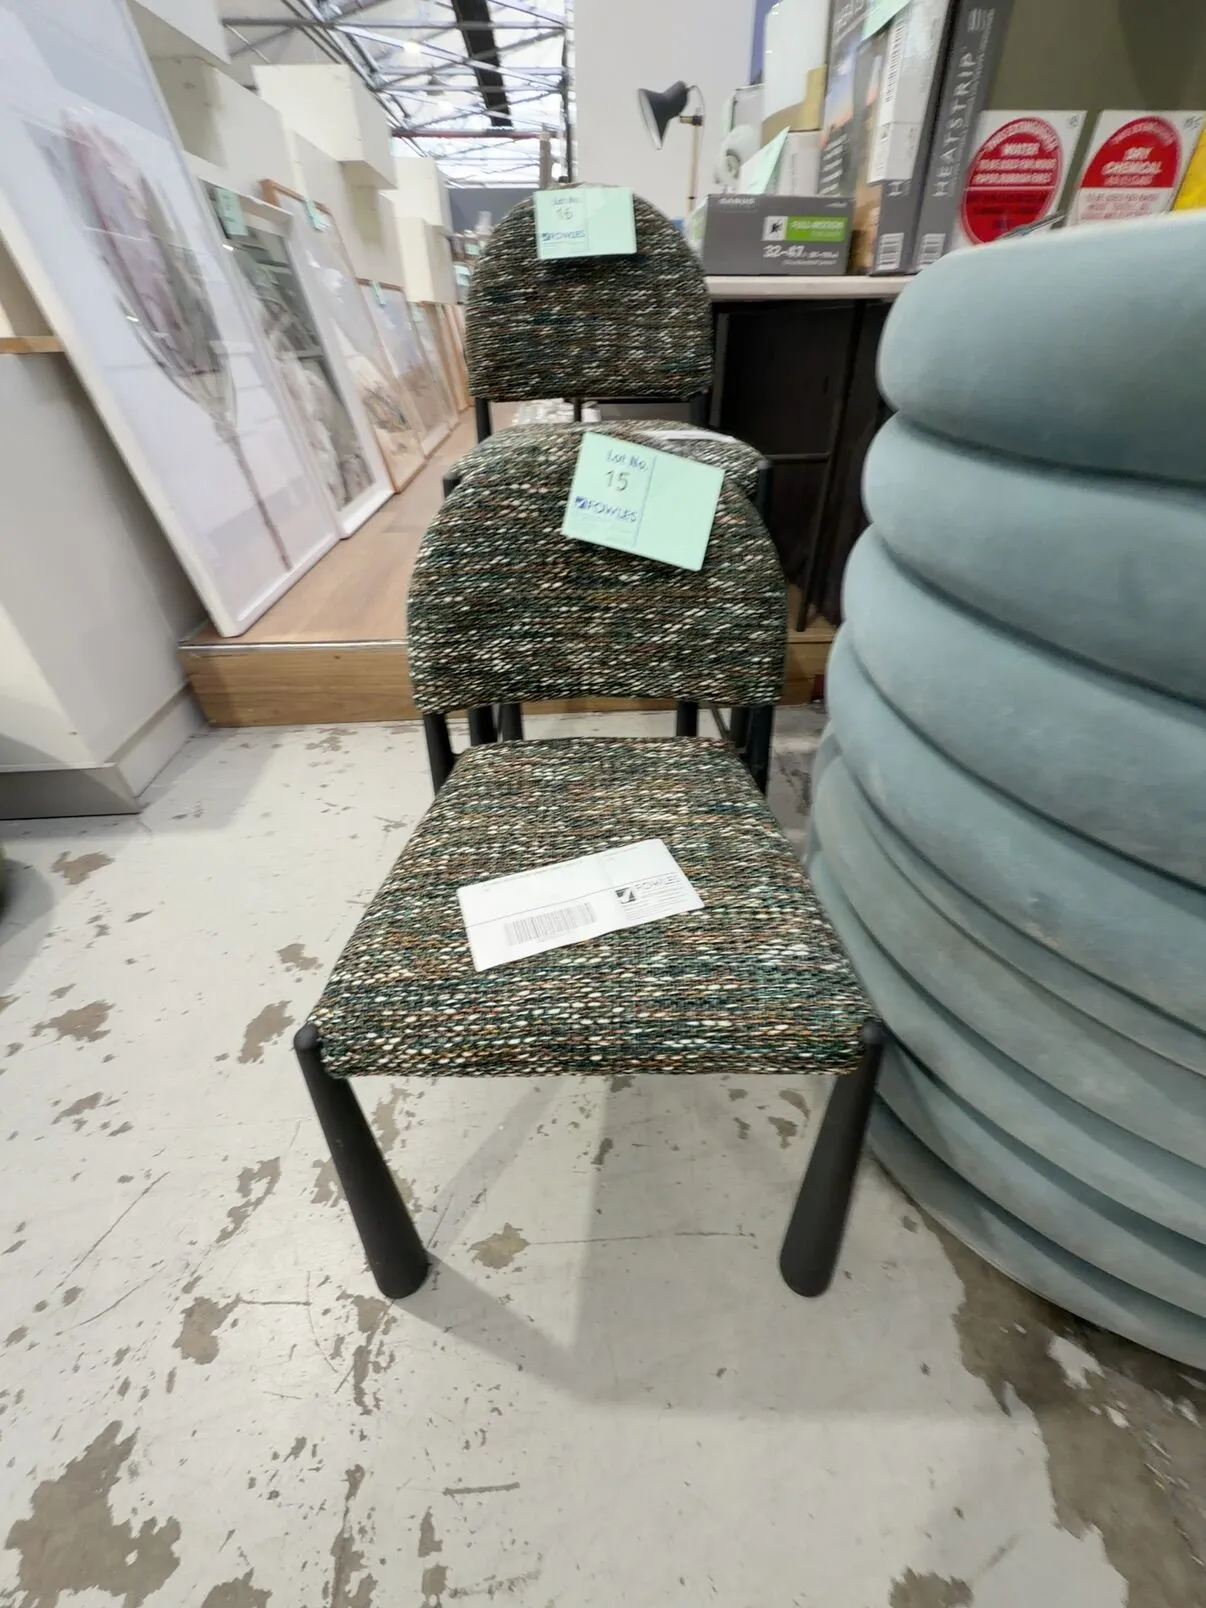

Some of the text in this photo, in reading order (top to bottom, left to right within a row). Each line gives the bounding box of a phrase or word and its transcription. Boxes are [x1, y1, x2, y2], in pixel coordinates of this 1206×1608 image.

[932, 52, 977, 197] HEATSTRIP
[606, 469, 630, 491] 15
[588, 500, 637, 522] FOWLES
